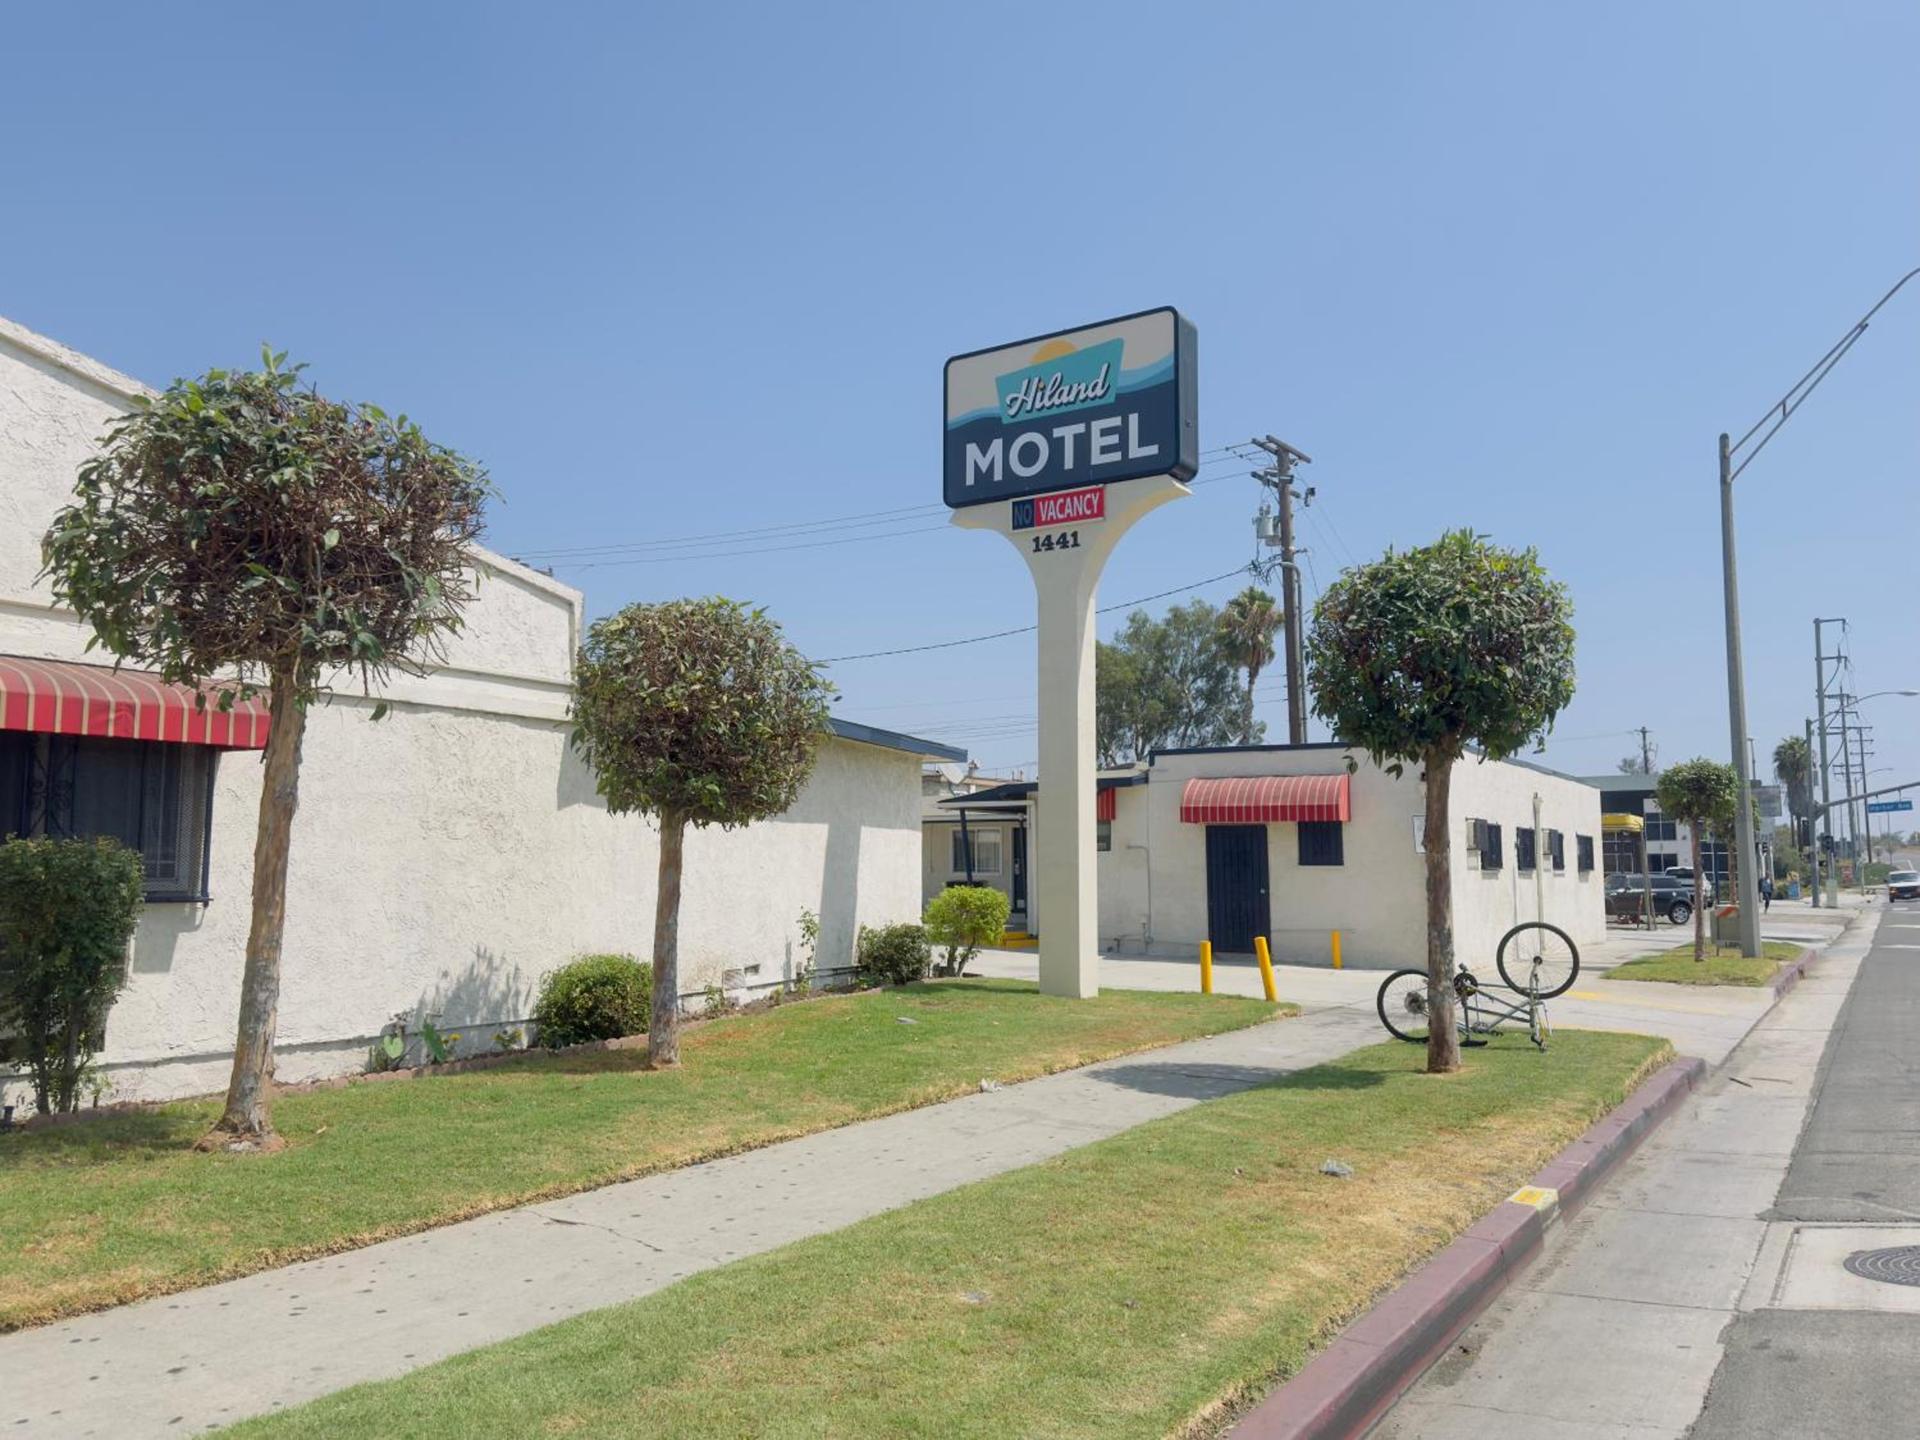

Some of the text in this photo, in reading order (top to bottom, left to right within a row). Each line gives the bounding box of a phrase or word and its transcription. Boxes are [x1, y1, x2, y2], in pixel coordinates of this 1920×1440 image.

[1005, 363, 1109, 417] Hiland
[965, 413, 1159, 486] MOTEL
[1014, 492, 1099, 527] NO VACANCY
[1032, 530, 1081, 553] 1441
